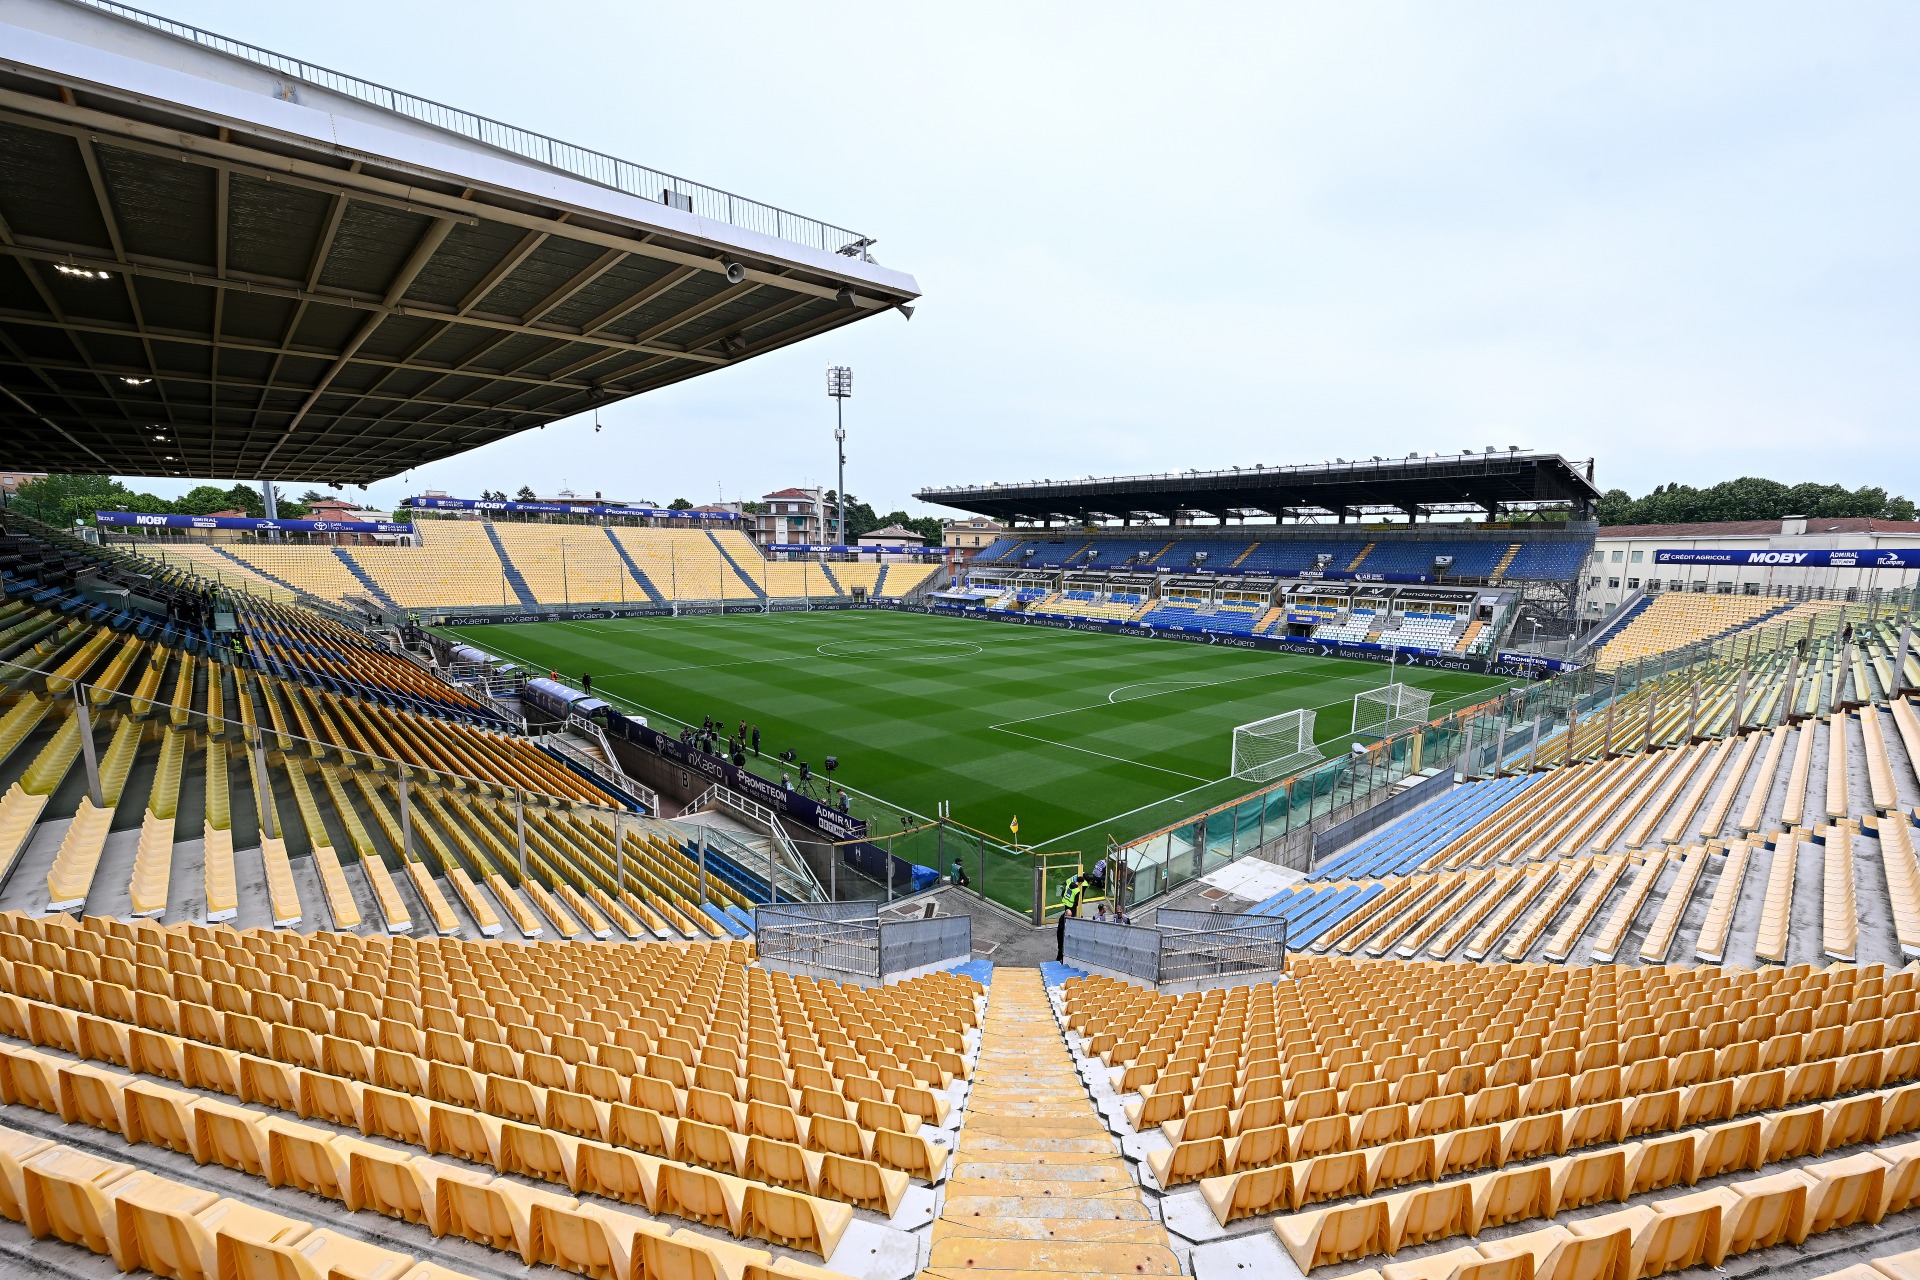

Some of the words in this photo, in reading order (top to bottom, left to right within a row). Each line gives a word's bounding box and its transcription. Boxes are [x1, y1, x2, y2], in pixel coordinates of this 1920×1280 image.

[475, 501, 507, 510] MOBY
[136, 515, 168, 525] MOBY
[1747, 552, 1808, 564] MOBY
[1830, 551, 1858, 559] ADMIRAL
[646, 609, 668, 617] Partner
[1163, 631, 1181, 639] Match
[1181, 632, 1204, 643] Partner
[1339, 649, 1364, 659] Match
[1366, 651, 1398, 663] Partnr
[1503, 654, 1548, 666] PROMETEON
[682, 771, 689, 788] B
[736, 769, 787, 803] PROMETEON
[816, 804, 852, 830] ADMIRAL
